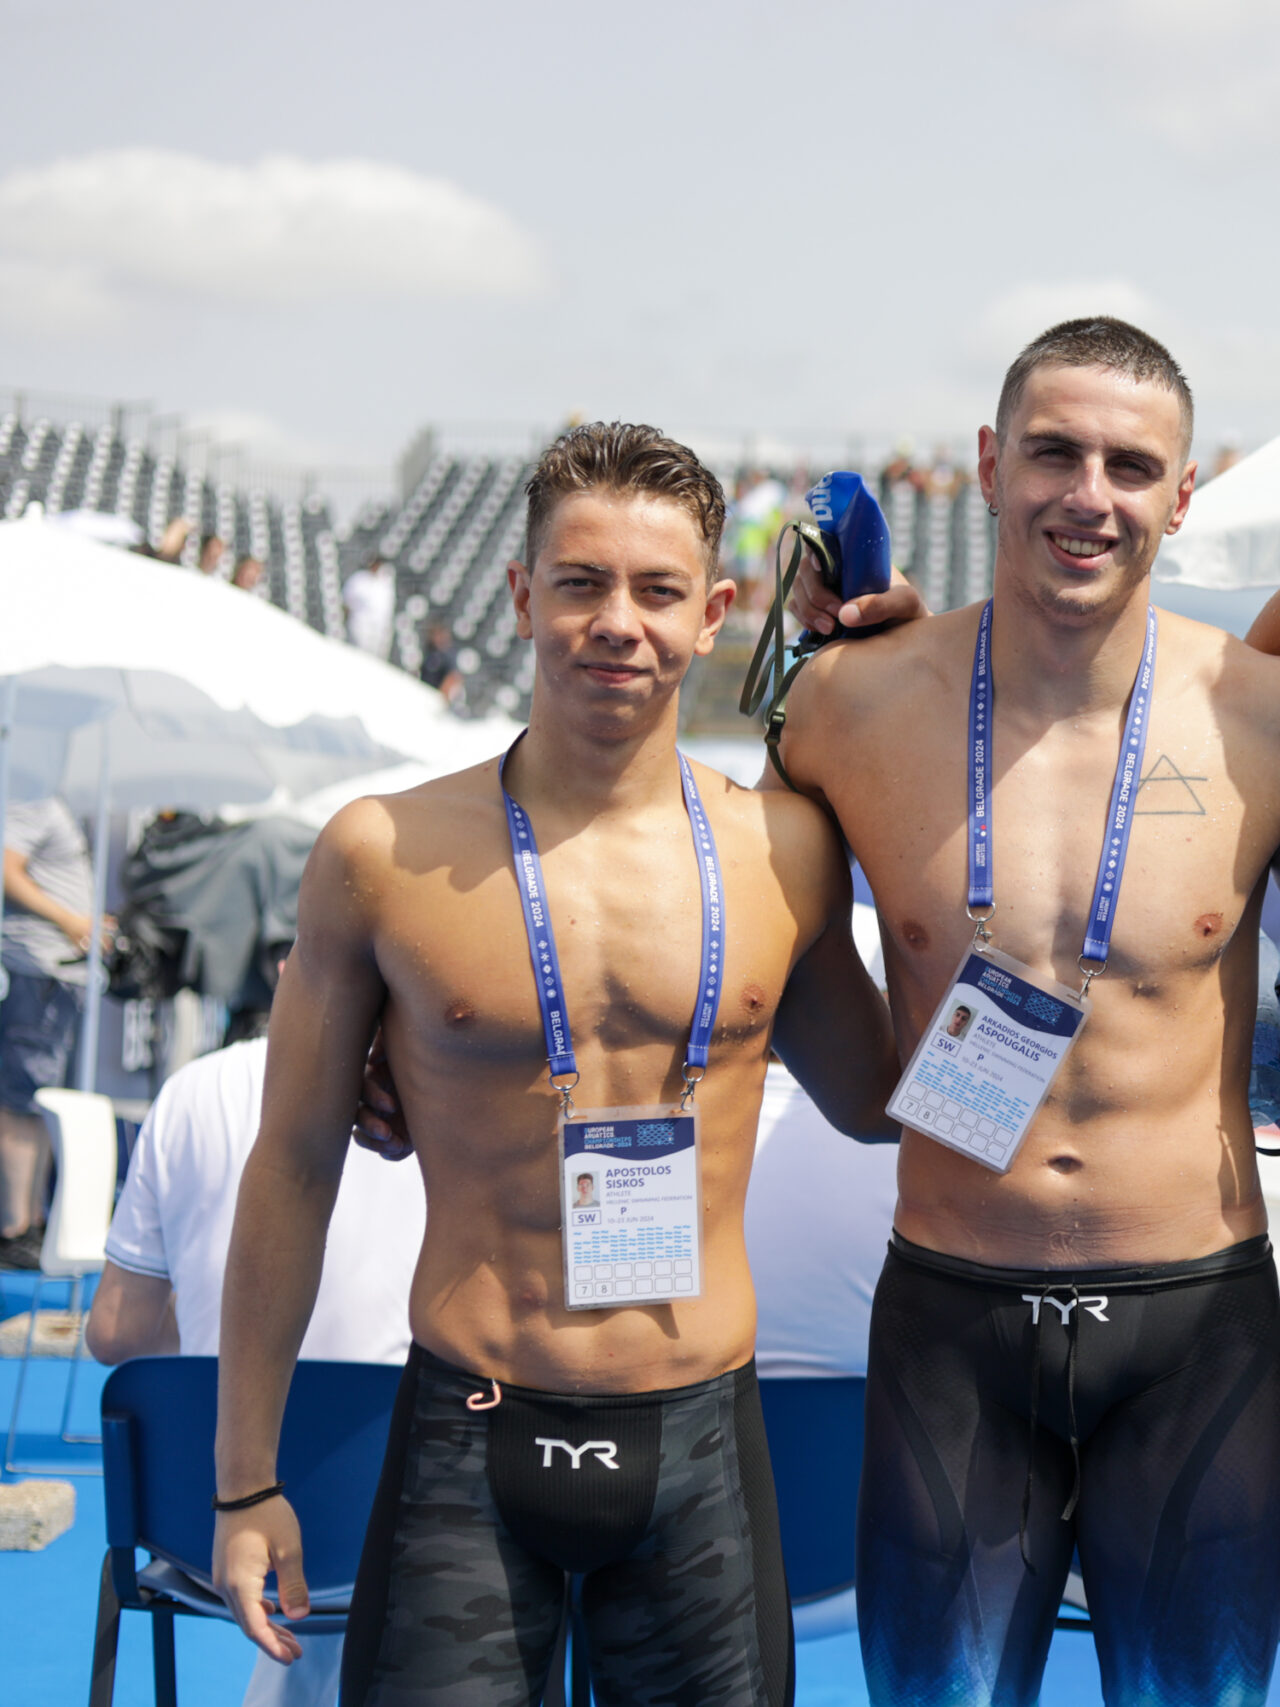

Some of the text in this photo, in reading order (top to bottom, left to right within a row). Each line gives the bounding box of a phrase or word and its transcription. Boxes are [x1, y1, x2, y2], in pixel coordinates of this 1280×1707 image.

[976, 739, 985, 818] BELGRADE 2024
[1114, 752, 1136, 830] BELGRADE 2024
[522, 849, 544, 928] BELGRADE 2024
[704, 856, 720, 932] BELGRADE 2024
[936, 1037, 956, 1053] SW
[976, 1022, 1042, 1062] ASPOUGALIS
[981, 1015, 1058, 1059] ARKADIOS GEORGIOS
[976, 1053, 985, 1062] P
[907, 1102, 929, 1119] 7 8
[605, 1165, 671, 1178] APOSTOLOS
[606, 1177, 645, 1189] SISKOS
[578, 1213, 596, 1223] SW
[620, 1206, 627, 1215] P
[582, 1285, 607, 1295] 7 8
[1021, 1294, 1110, 1325] TYR
[535, 1437, 620, 1469] TYR
